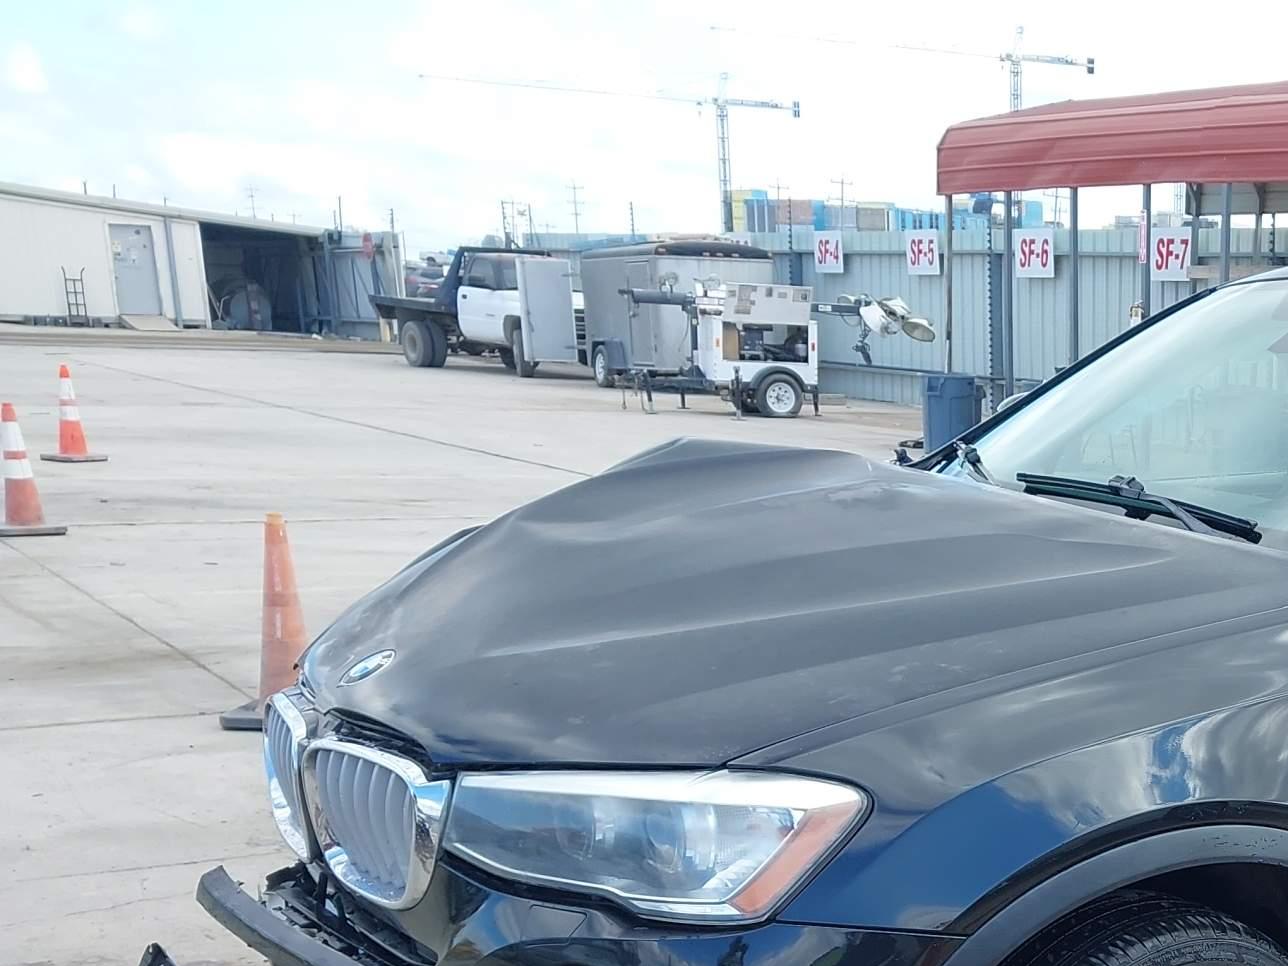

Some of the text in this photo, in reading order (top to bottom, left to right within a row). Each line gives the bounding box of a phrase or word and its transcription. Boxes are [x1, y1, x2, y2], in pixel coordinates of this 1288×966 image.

[818, 239, 840, 265] SF-4
[910, 238, 935, 266] SF-5
[1019, 238, 1049, 268] SF-6
[1155, 238, 1189, 271] SF-7
